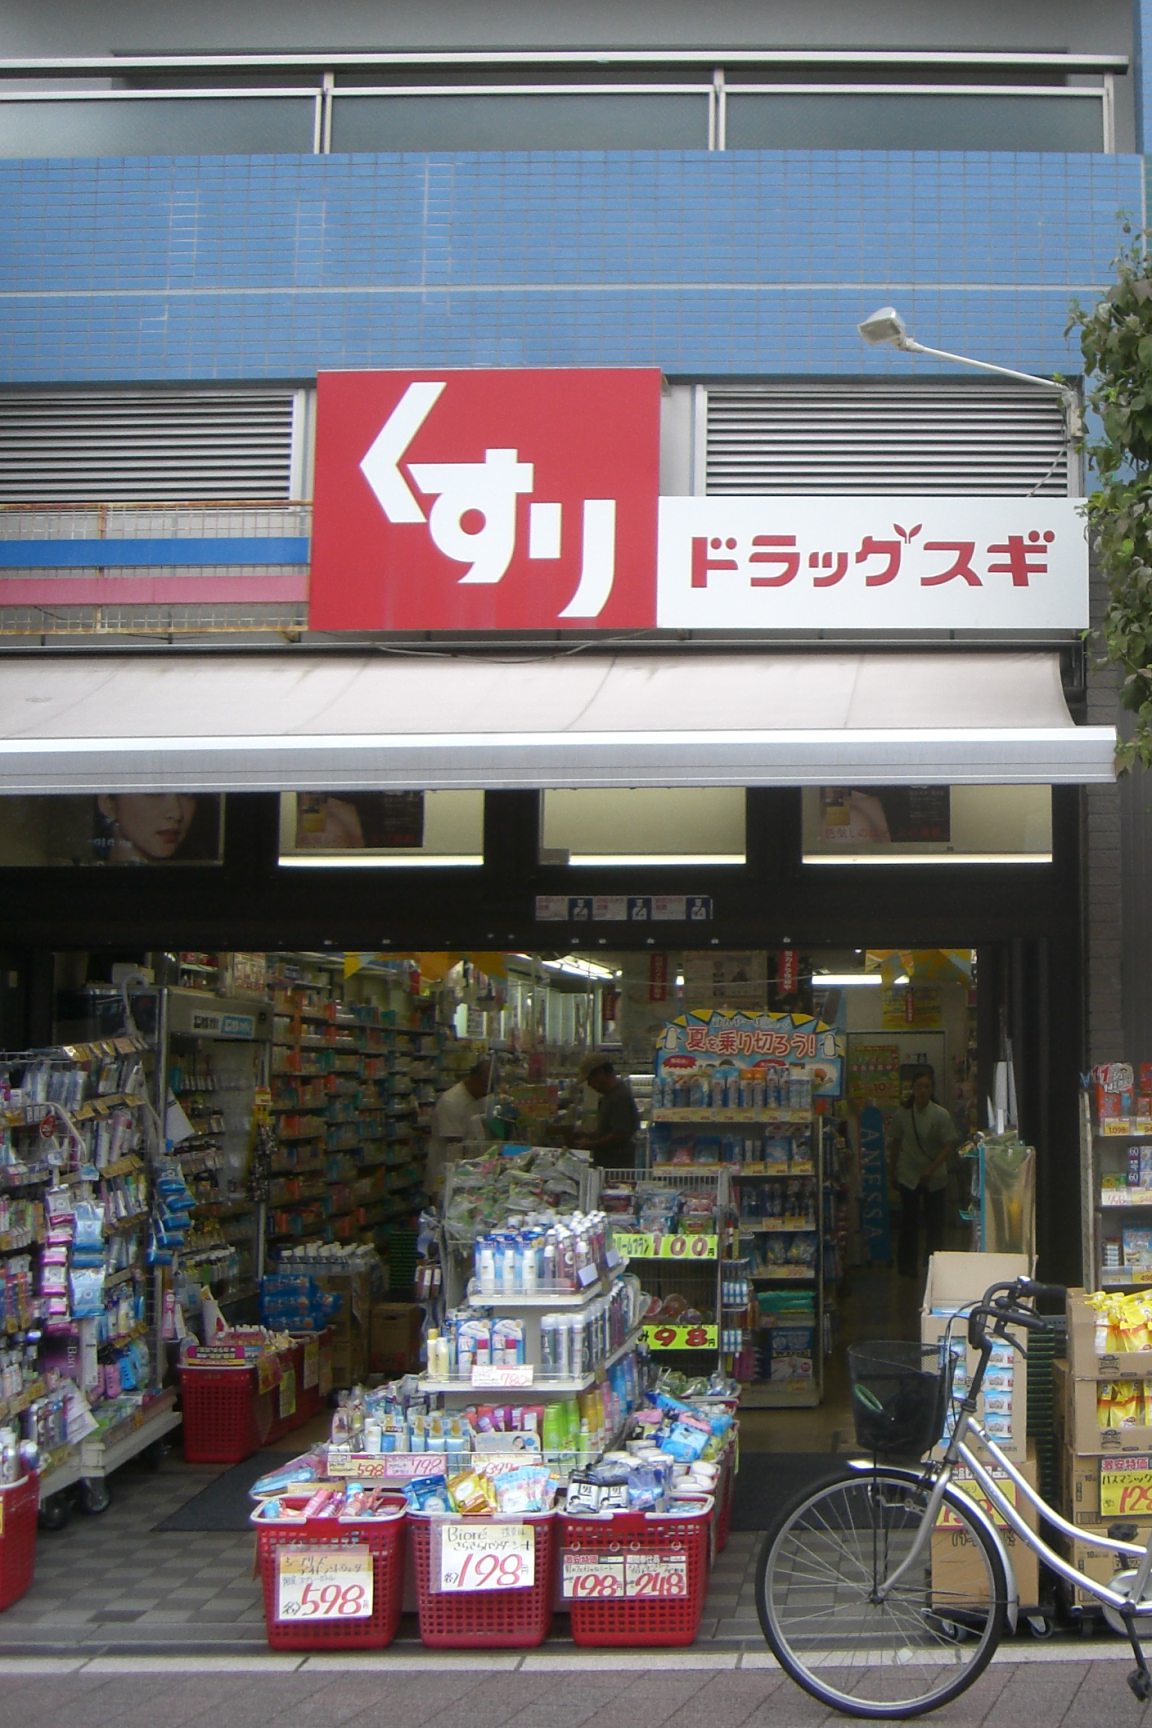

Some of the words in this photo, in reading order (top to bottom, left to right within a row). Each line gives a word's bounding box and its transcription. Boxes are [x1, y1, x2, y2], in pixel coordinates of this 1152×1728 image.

[360, 381, 616, 618] くすり
[691, 523, 1055, 588] ドラッグスギ
[686, 1026, 818, 1057] 夏を乗り切ろう!
[1102, 1457, 1149, 1470] 激安特価
